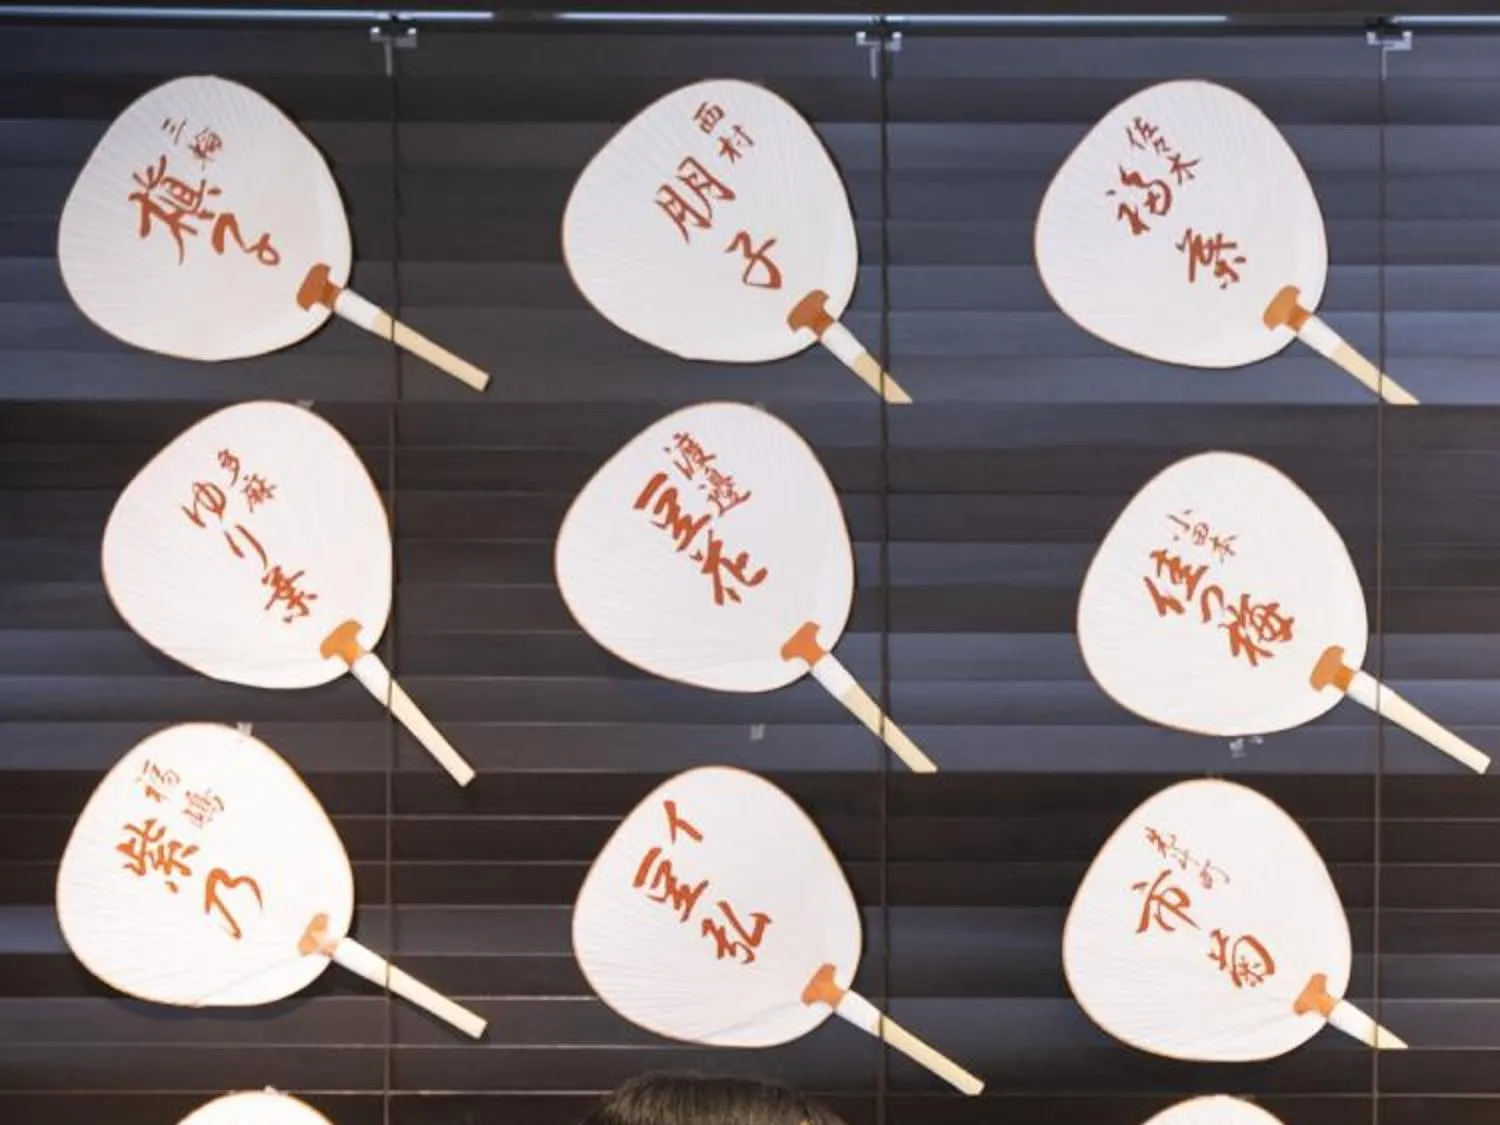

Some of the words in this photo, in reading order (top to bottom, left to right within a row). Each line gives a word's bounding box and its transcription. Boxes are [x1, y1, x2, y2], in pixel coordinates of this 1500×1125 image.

[692, 100, 755, 165] 西村
[654, 155, 783, 291] 朋子
[181, 481, 318, 624] ゆり葉
[632, 471, 769, 607] 豆花
